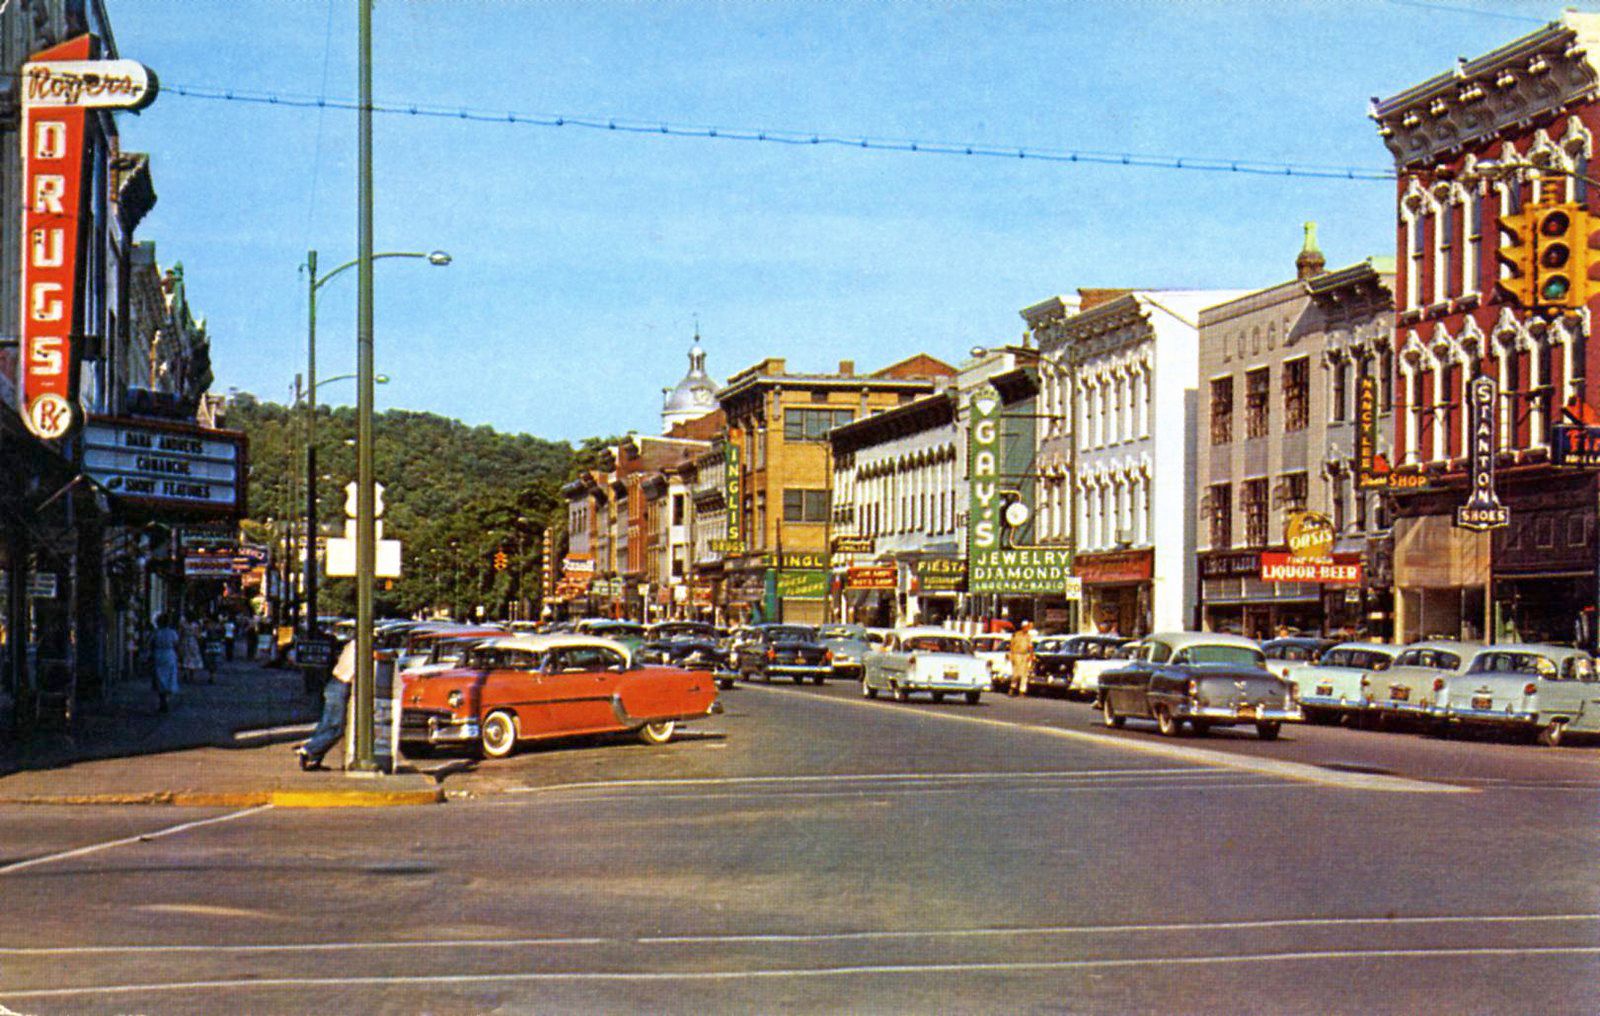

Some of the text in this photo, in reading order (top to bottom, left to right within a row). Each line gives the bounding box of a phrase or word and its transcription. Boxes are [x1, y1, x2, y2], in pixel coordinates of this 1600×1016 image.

[29, 120, 66, 376] DRUGS
[1477, 385, 1490, 503] STANTON
[975, 420, 995, 548] GAY'S
[1389, 473, 1427, 486] SHOP
[728, 447, 739, 540] INGLIS
[1461, 510, 1505, 521] SHOES
[977, 551, 1070, 566] JEWELRY
[918, 561, 966, 572] FIESTA
[975, 567, 1071, 580] DIAMONDS
